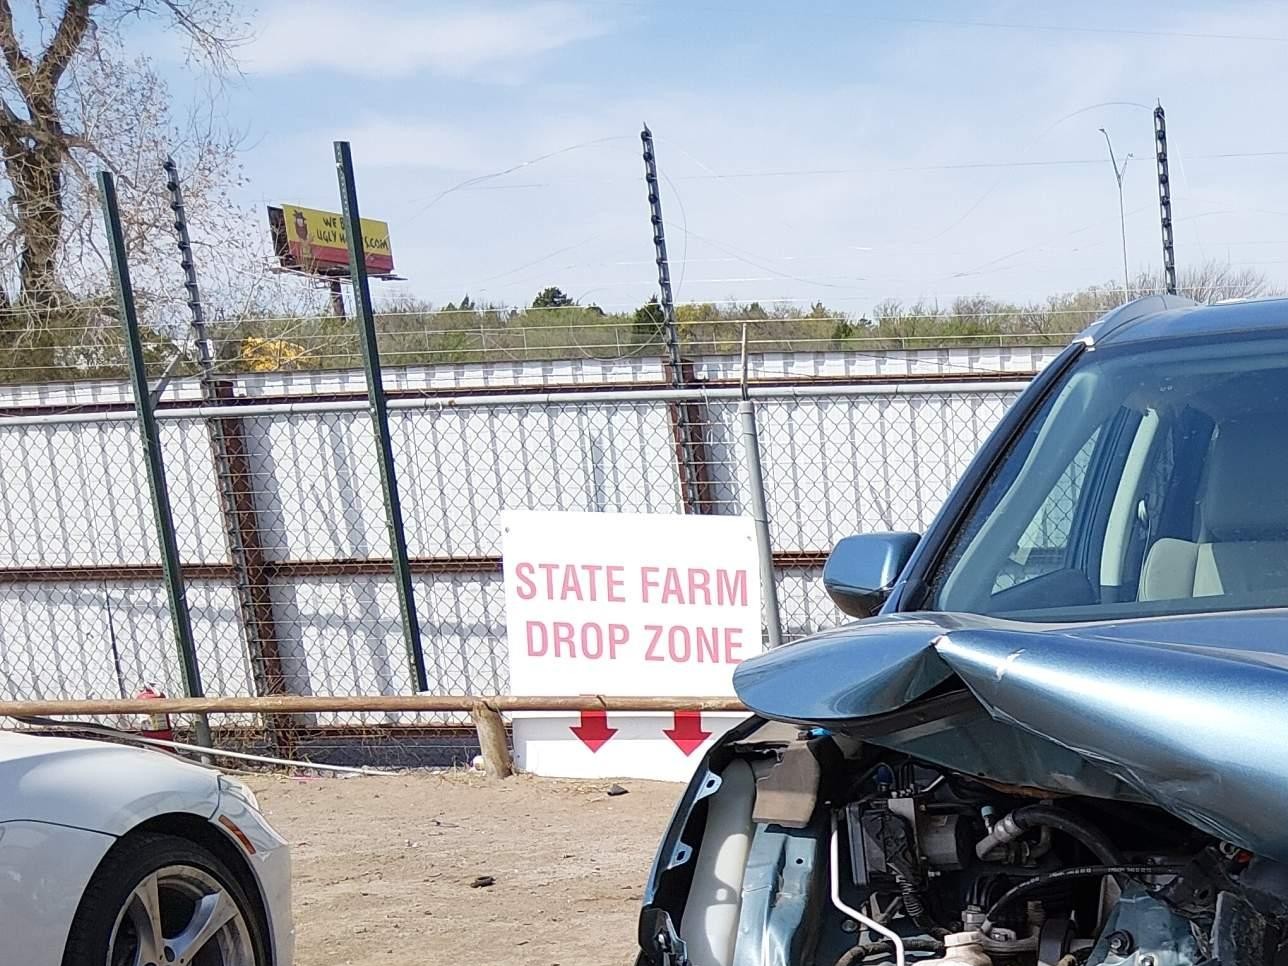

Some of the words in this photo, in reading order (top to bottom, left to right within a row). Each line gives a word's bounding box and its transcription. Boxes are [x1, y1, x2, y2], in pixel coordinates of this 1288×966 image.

[316, 228, 337, 243] UGLY
[322, 216, 337, 228] WE
[515, 562, 626, 603] STATE
[640, 566, 748, 607] FARM
[526, 620, 630, 660] DROP
[643, 625, 744, 665] ZONE
